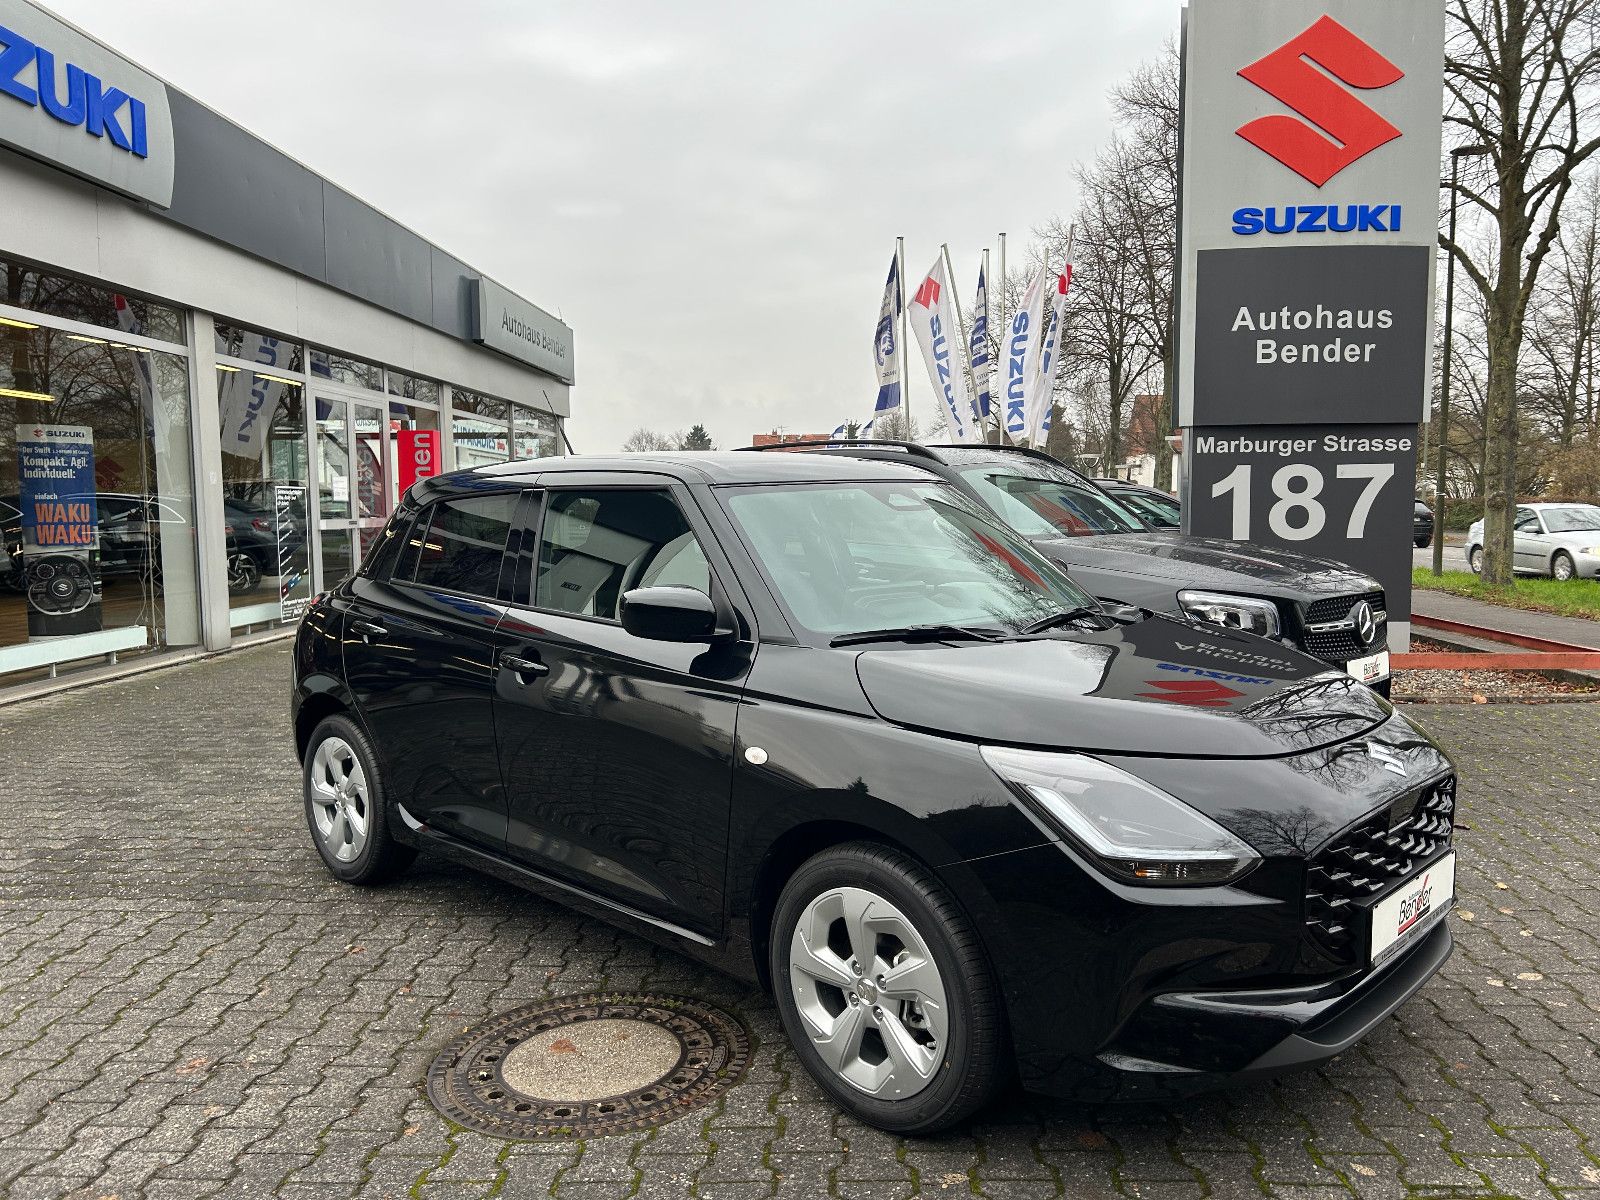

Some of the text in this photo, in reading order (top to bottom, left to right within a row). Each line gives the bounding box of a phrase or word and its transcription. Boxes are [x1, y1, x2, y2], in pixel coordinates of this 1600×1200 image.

[1231, 204, 1402, 236] SUZUKI
[1231, 304, 1394, 332] Autohaus
[501, 307, 567, 359] Autohaus Bender
[1256, 337, 1377, 364] Bender
[1006, 311, 1029, 433] SUZUKI
[45, 430, 85, 438] SUZUKI
[1196, 434, 1412, 457] Marburger Strasse
[23, 456, 68, 469] Kompakt.
[24, 468, 76, 479] Individuell:
[34, 492, 58, 500] einfach
[1211, 463, 1396, 542] 187
[34, 503, 90, 523] WAKU
